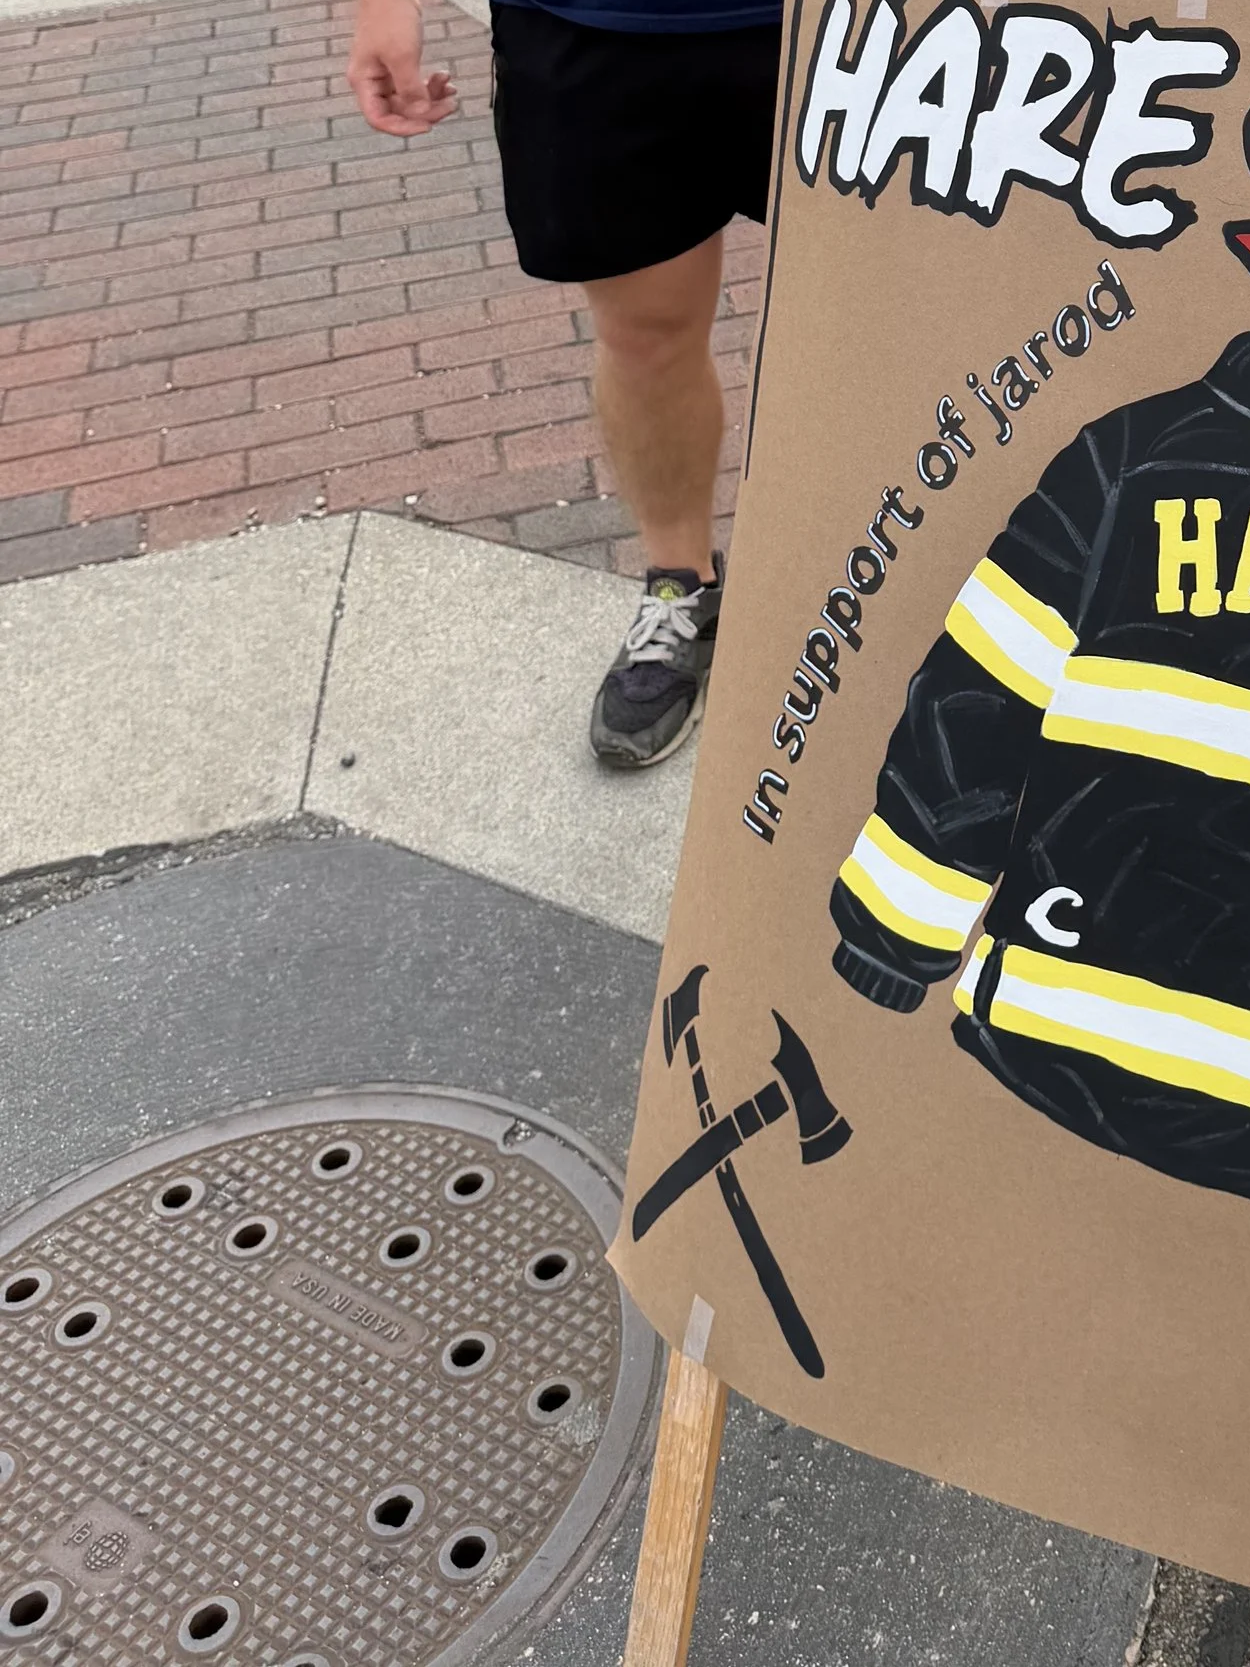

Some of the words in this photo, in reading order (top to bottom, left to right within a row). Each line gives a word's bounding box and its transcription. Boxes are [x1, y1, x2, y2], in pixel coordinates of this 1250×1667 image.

[772, 486, 925, 764] support
[915, 394, 976, 491] of
[966, 257, 1137, 447] jarod
[292, 1271, 329, 1302] USA
[326, 1293, 352, 1315] IN
[350, 1304, 405, 1342] MADE
